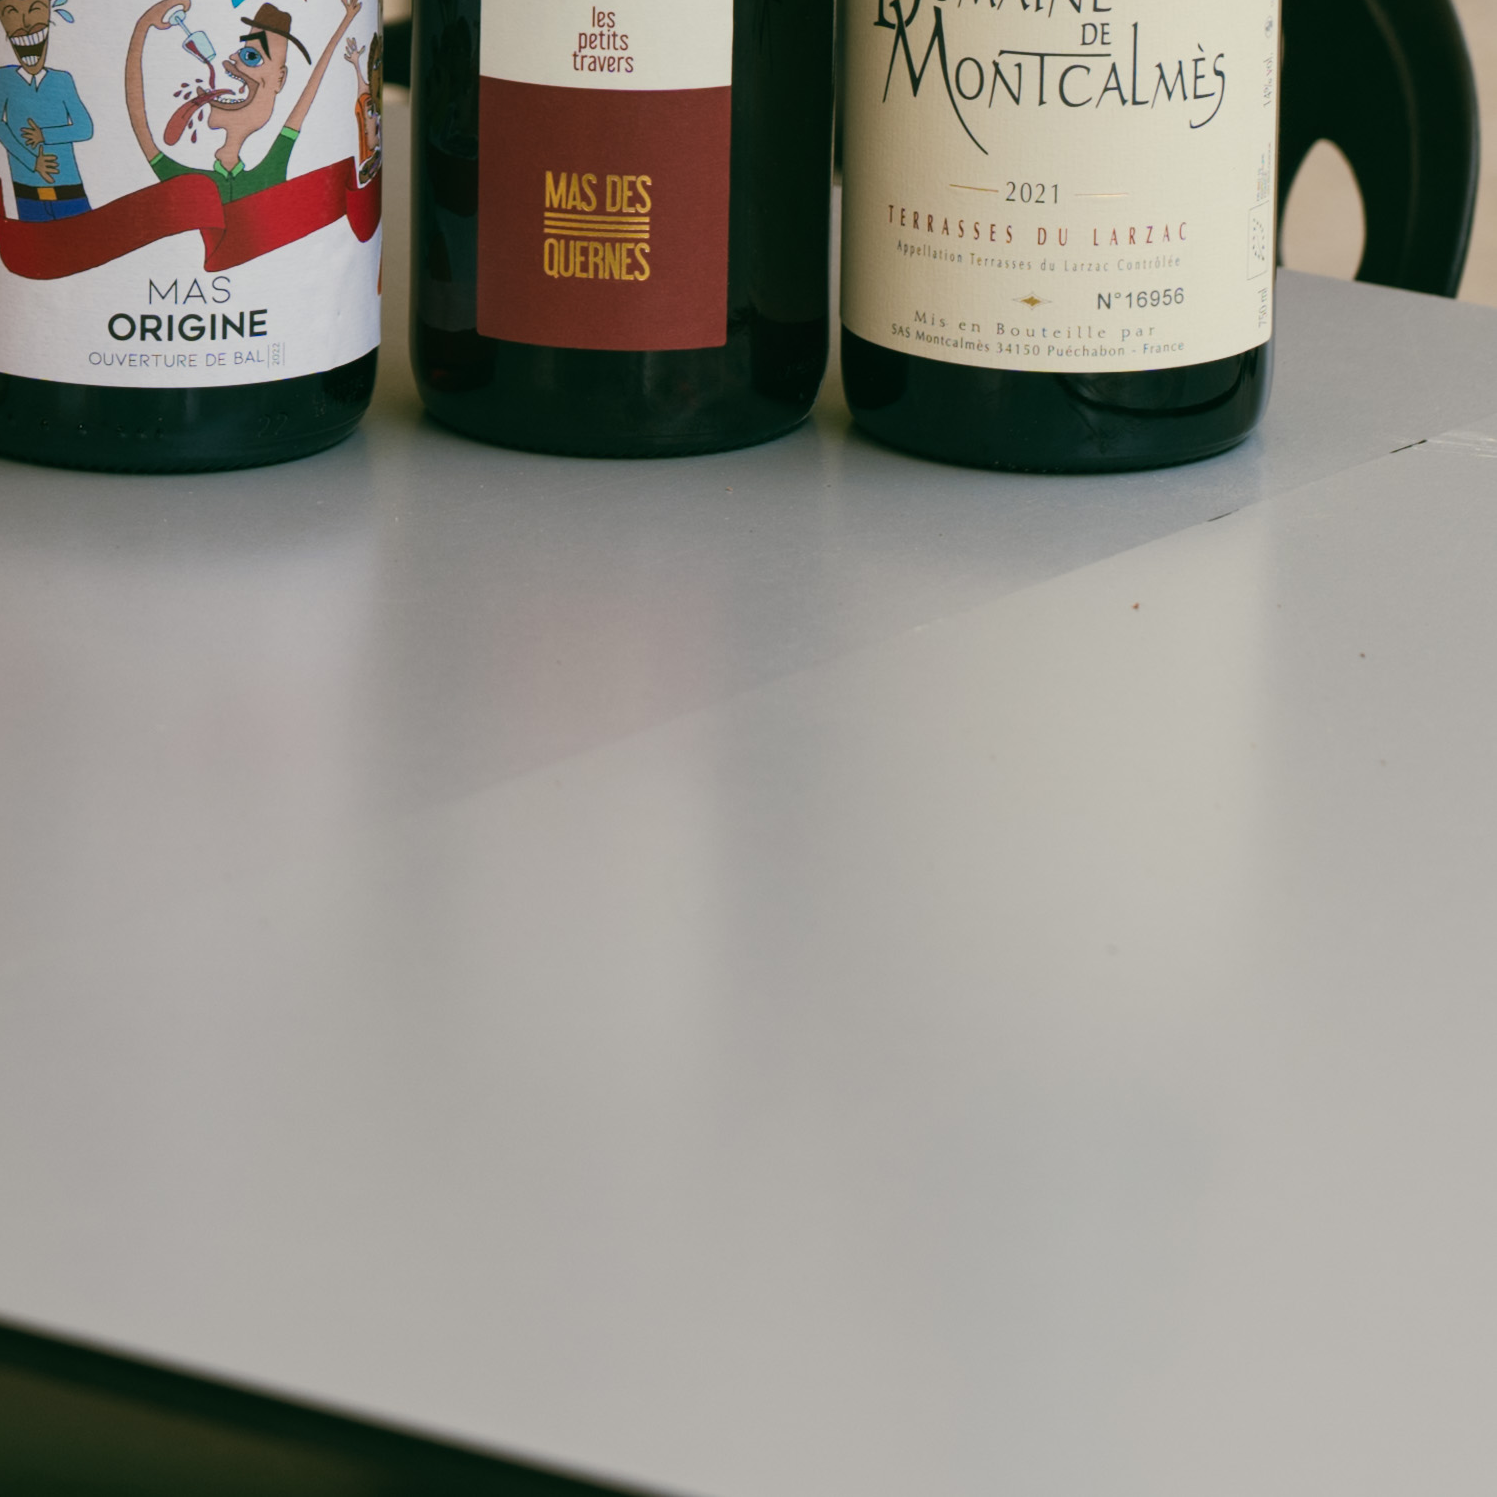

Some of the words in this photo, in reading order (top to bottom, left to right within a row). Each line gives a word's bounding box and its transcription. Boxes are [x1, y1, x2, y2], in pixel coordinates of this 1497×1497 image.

[591, 5, 616, 29] les
[577, 29, 630, 54] petits
[1080, 22, 1112, 45] DE
[572, 49, 635, 74] travers
[545, 170, 597, 213] MAS
[605, 174, 652, 213] DES
[1005, 180, 1060, 204] 2021
[887, 204, 1014, 245] TERRASSES
[1037, 227, 1069, 247] DU
[1093, 222, 1189, 247] LARZAC
[543, 237, 651, 281] QUERNES
[897, 240, 963, 263] Appellation
[969, 252, 1033, 271] Terrasses
[1040, 258, 1056, 272] du
[1064, 260, 1109, 272] Larzac
[1117, 255, 1182, 272] Contrôlée
[148, 276, 232, 305] MAS
[107, 309, 269, 342] ORIGINE
[891, 322, 912, 339] SAS
[914, 329, 991, 353] Montcalmès
[996, 341, 1041, 357] 34150
[1047, 343, 1125, 358] Puéchabon
[1142, 341, 1185, 355] France
[914, 310, 947, 328] Mis
[958, 320, 982, 334] en
[995, 322, 1107, 339] Bouteille
[1121, 325, 1156, 342] par
[88, 351, 198, 368] OUVERTURE
[205, 352, 227, 367] DE
[233, 350, 265, 365] BAL
